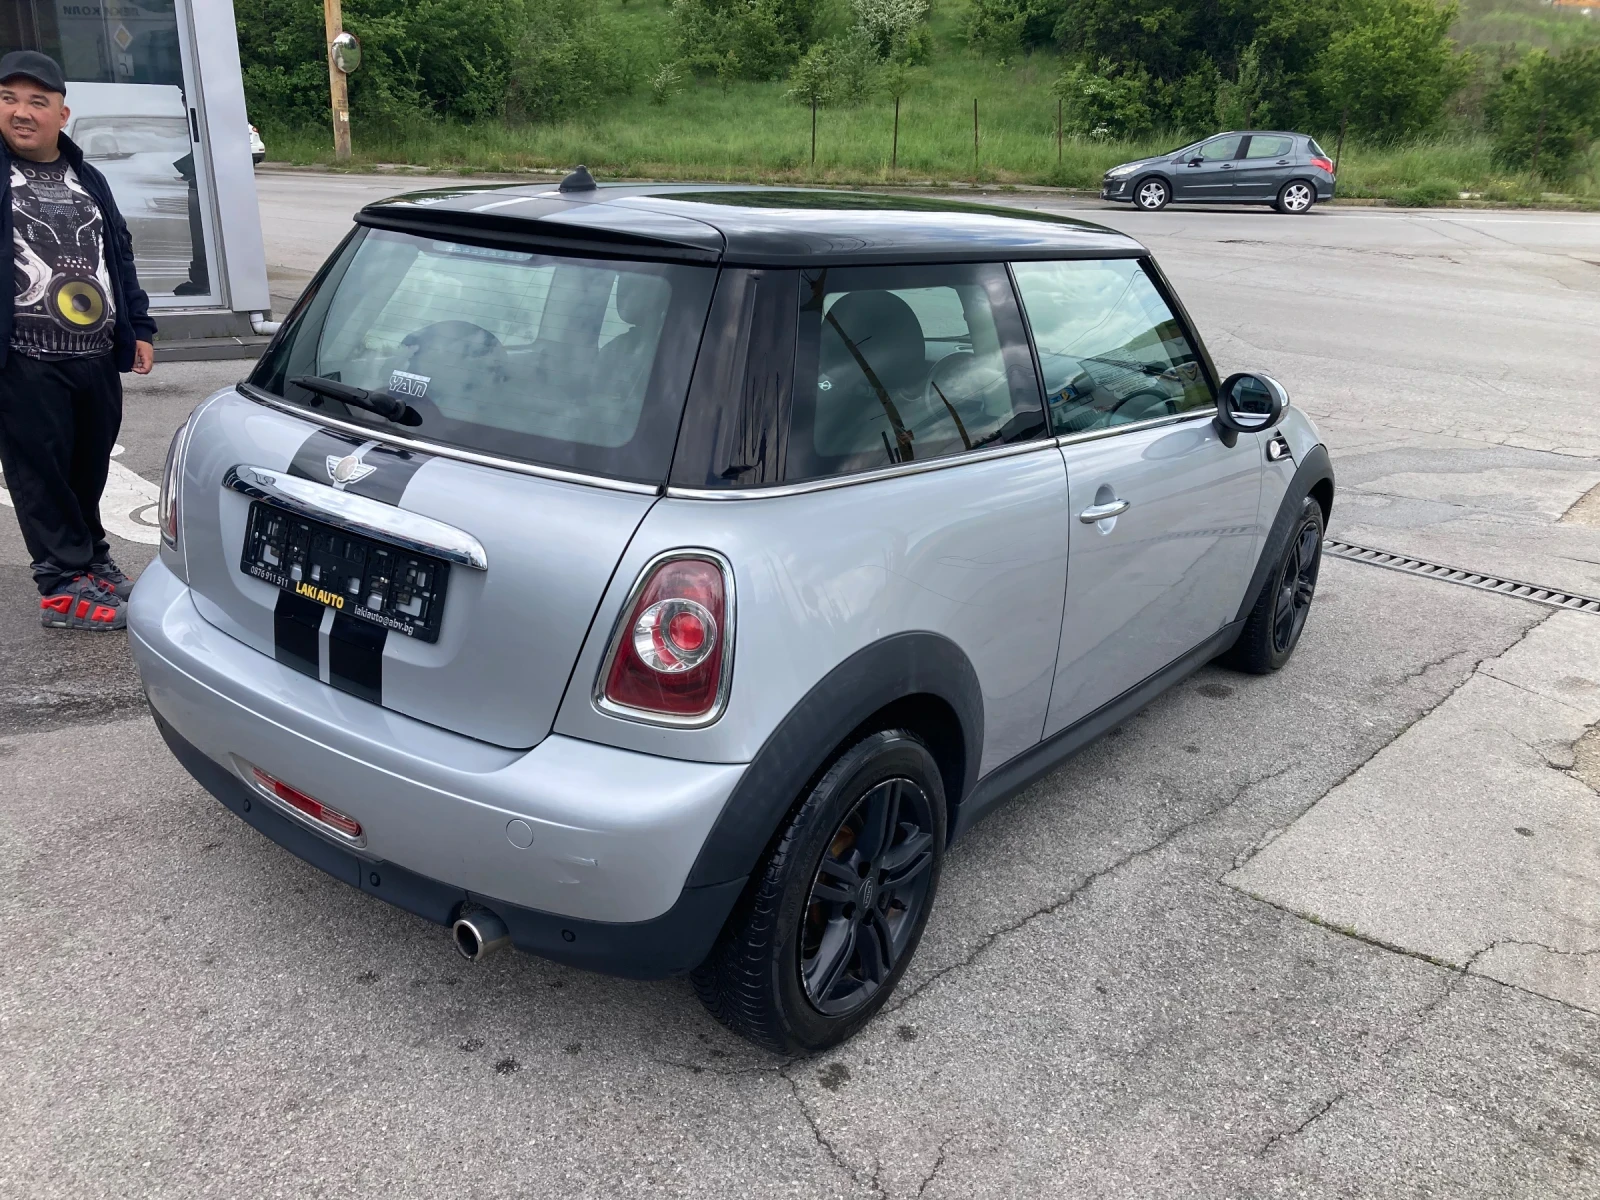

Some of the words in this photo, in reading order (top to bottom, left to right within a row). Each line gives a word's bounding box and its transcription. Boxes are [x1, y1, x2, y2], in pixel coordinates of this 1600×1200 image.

[250, 565, 265, 578] 0876
[265, 571, 277, 583] 911
[276, 576, 289, 588] 511
[41, 595, 116, 622] AIR
[295, 580, 318, 600] LAKI
[316, 588, 345, 609] AUTO
[354, 604, 415, 636] lakiauto@abv.bg
